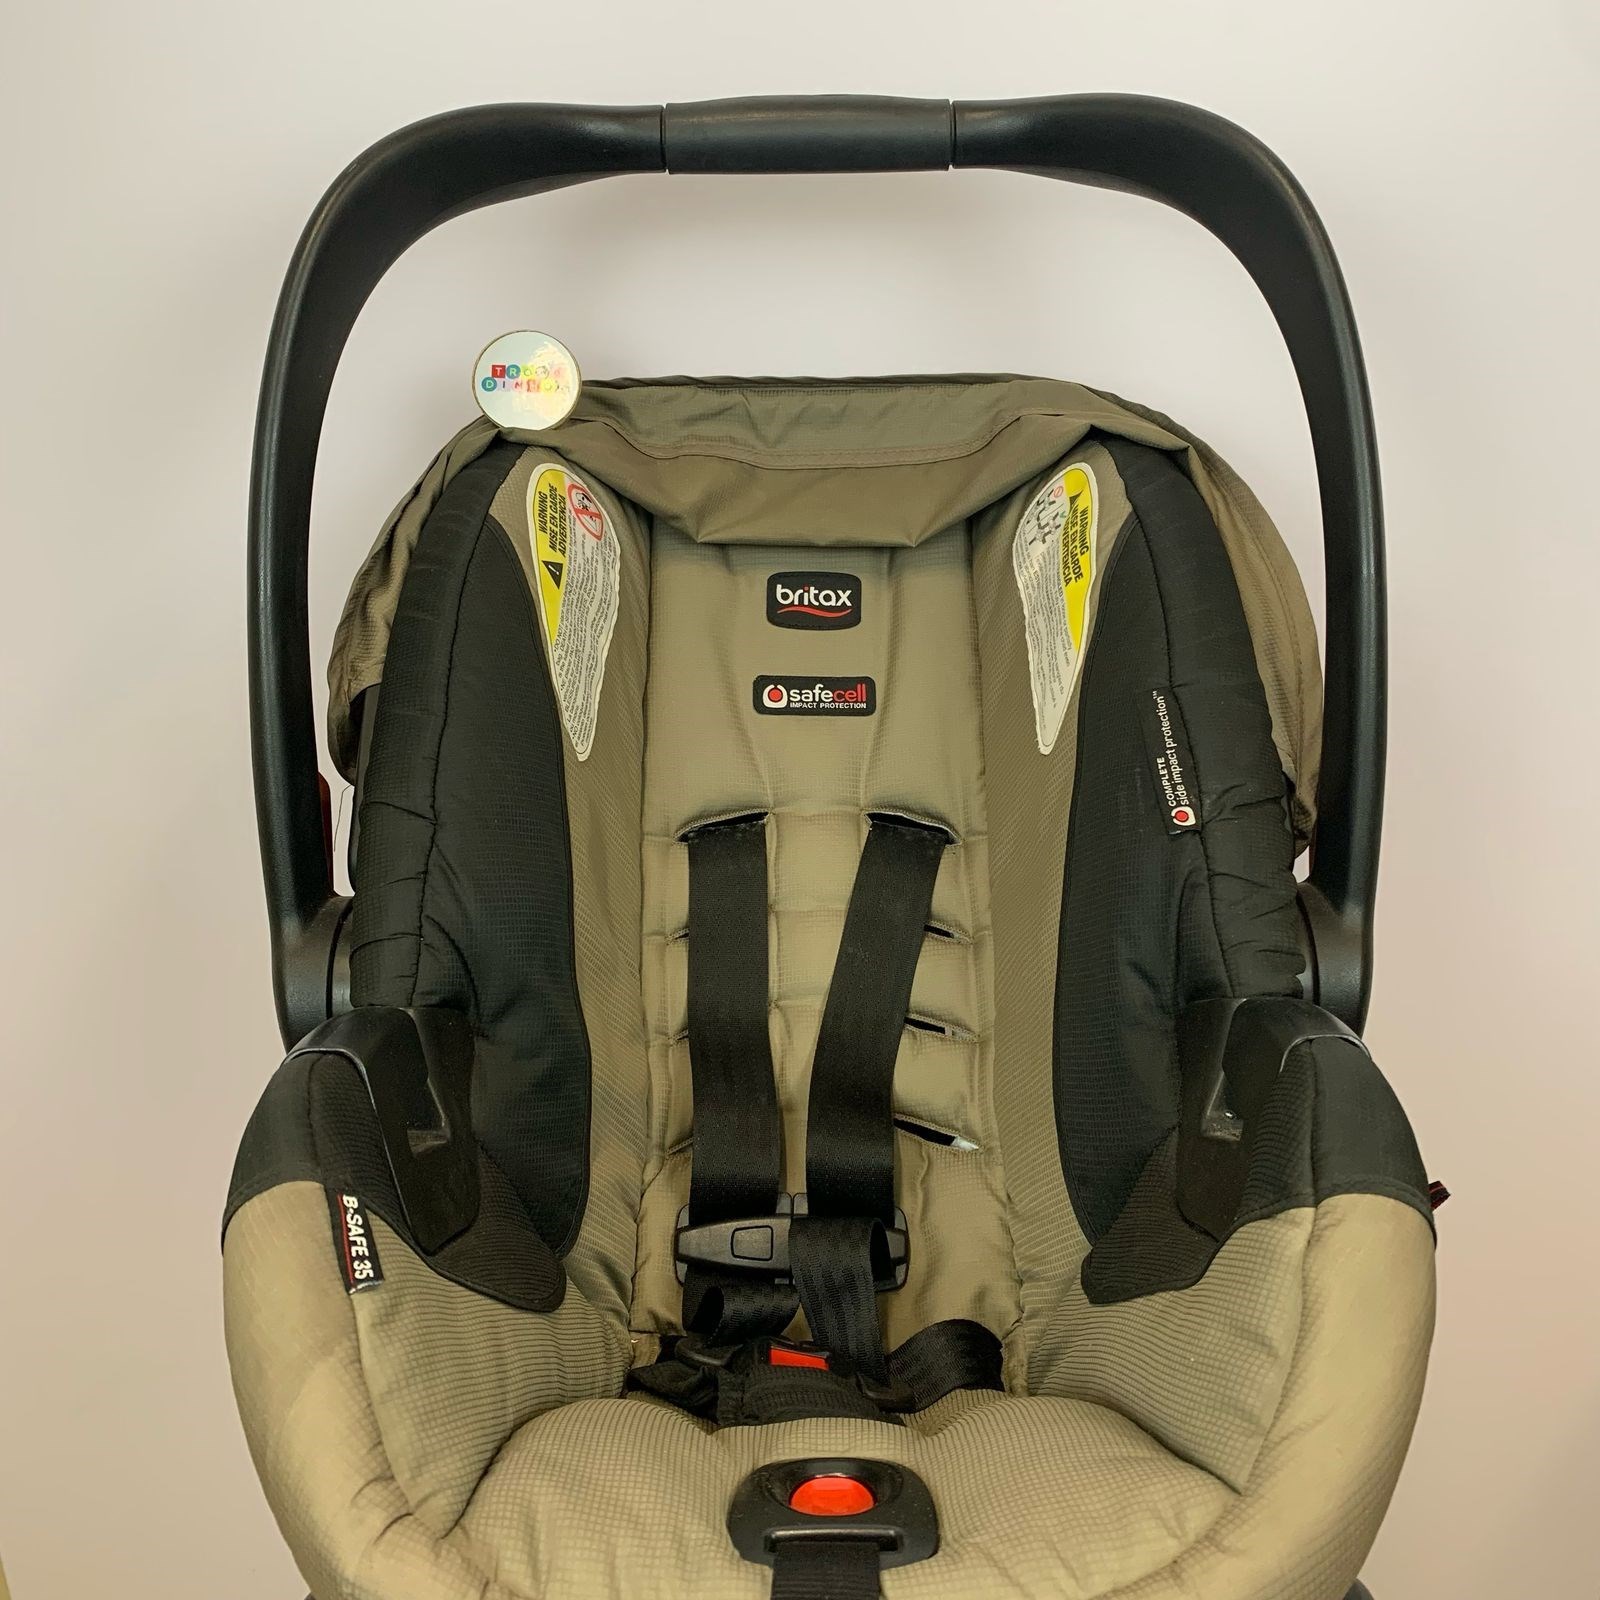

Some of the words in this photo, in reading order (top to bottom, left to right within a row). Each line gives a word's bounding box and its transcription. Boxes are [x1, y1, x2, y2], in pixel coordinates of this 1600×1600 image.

[538, 490, 548, 534] WARNING
[549, 483, 558, 514] GARDE
[549, 512, 558, 528] EN
[557, 493, 567, 558] ADVERTENCIA
[1079, 506, 1089, 556] WARNING
[548, 527, 558, 552] MISE
[1069, 530, 1079, 546] EN
[1070, 544, 1084, 583] GARDE
[776, 584, 853, 607] britax
[789, 683, 867, 702] safecell
[1156, 756, 1177, 807] COMPLETE
[1165, 748, 1183, 785] impact
[1176, 784, 1189, 806] side
[342, 1194, 370, 1258] B-SAFE
[353, 1260, 374, 1280] 35
